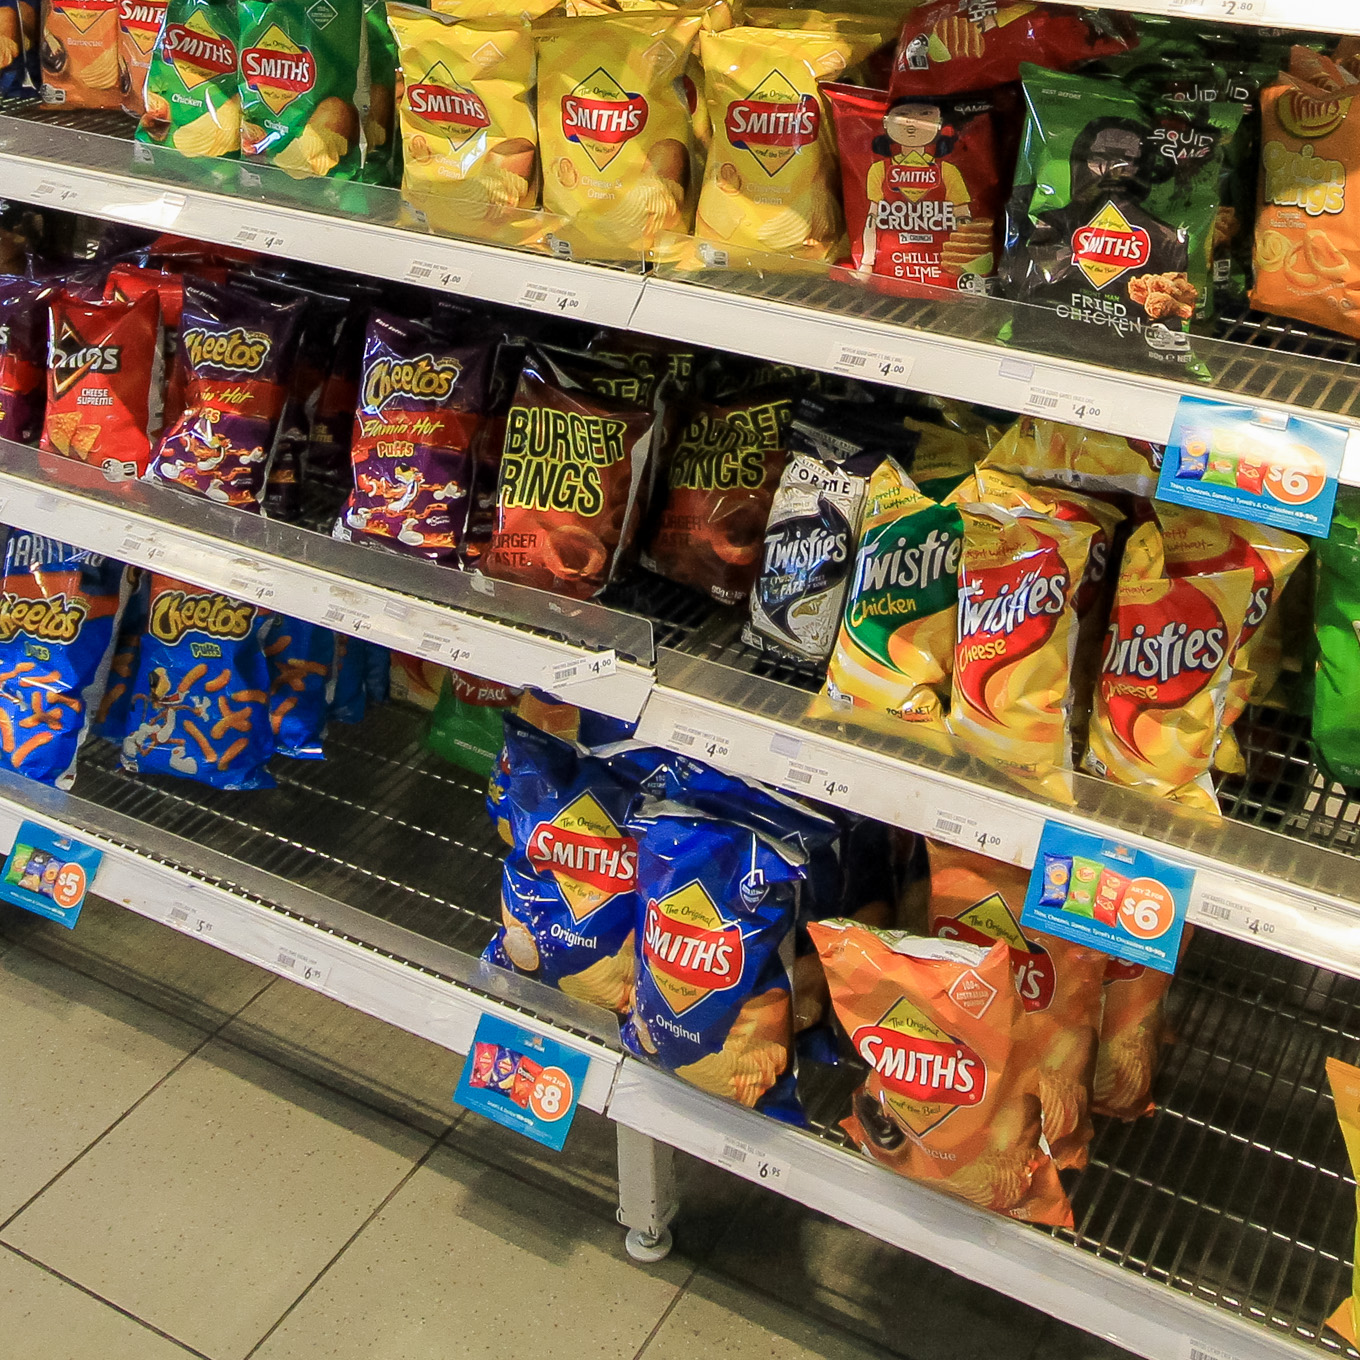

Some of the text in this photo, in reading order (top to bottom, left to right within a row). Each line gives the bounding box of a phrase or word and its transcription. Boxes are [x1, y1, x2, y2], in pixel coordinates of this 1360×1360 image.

[165, 28, 234, 66] SMITH'S
[245, 52, 311, 83] SMITH'S
[171, 92, 202, 108] Chicken
[408, 88, 487, 121] SMITH'S
[564, 99, 642, 133] SMITH'S
[729, 109, 815, 136] SMITH'S
[1151, 127, 1214, 146] SQUID
[1160, 144, 1211, 165] GAME
[1262, 141, 1346, 185] Onion
[889, 167, 937, 185] SMITH'S
[877, 200, 954, 218] DOUBLE
[875, 215, 957, 232] CRUNCH
[1077, 230, 1142, 261] SMITH'S
[891, 252, 941, 266] CHILLI
[894, 266, 942, 283] & LIME
[1070, 293, 1128, 318] FRIED
[1055, 303, 1141, 339] CHICKEN
[184, 329, 270, 372] Cheetos
[879, 362, 904, 376] $4.00
[81, 388, 108, 398] CHEESE
[217, 387, 254, 403] Hot
[363, 355, 459, 411] Cheetos
[76, 396, 114, 406] SUPREME
[1073, 404, 1101, 419] $4.00
[411, 418, 445, 436] Hot
[506, 407, 629, 469] BURGER
[376, 441, 414, 458] Puffs
[498, 458, 606, 517] RINGS
[763, 531, 847, 574] Twisties
[851, 532, 960, 600] Twistie
[151, 592, 255, 644] Cheetos
[850, 593, 917, 629] Chicken
[958, 570, 1066, 644] Twisties
[191, 642, 222, 659] Puffs
[958, 638, 1007, 673] Cheese
[704, 742, 728, 759] $4.00
[823, 780, 849, 797] $4.00
[560, 817, 611, 835] The Original
[974, 830, 1002, 849] $4.00
[533, 831, 636, 880] SMITH'S
[57, 868, 79, 894] $5
[663, 903, 714, 927] The Original
[1121, 895, 1162, 929] $6
[549, 923, 598, 950] Original
[1244, 916, 1276, 935] $4.00
[644, 908, 734, 977] SMITH'S
[655, 1013, 702, 1045] Original
[888, 1016, 940, 1039] The Original
[858, 1034, 976, 1093] SMITH'S
[534, 1084, 562, 1114] $8
[756, 1160, 781, 1178] $6.95
